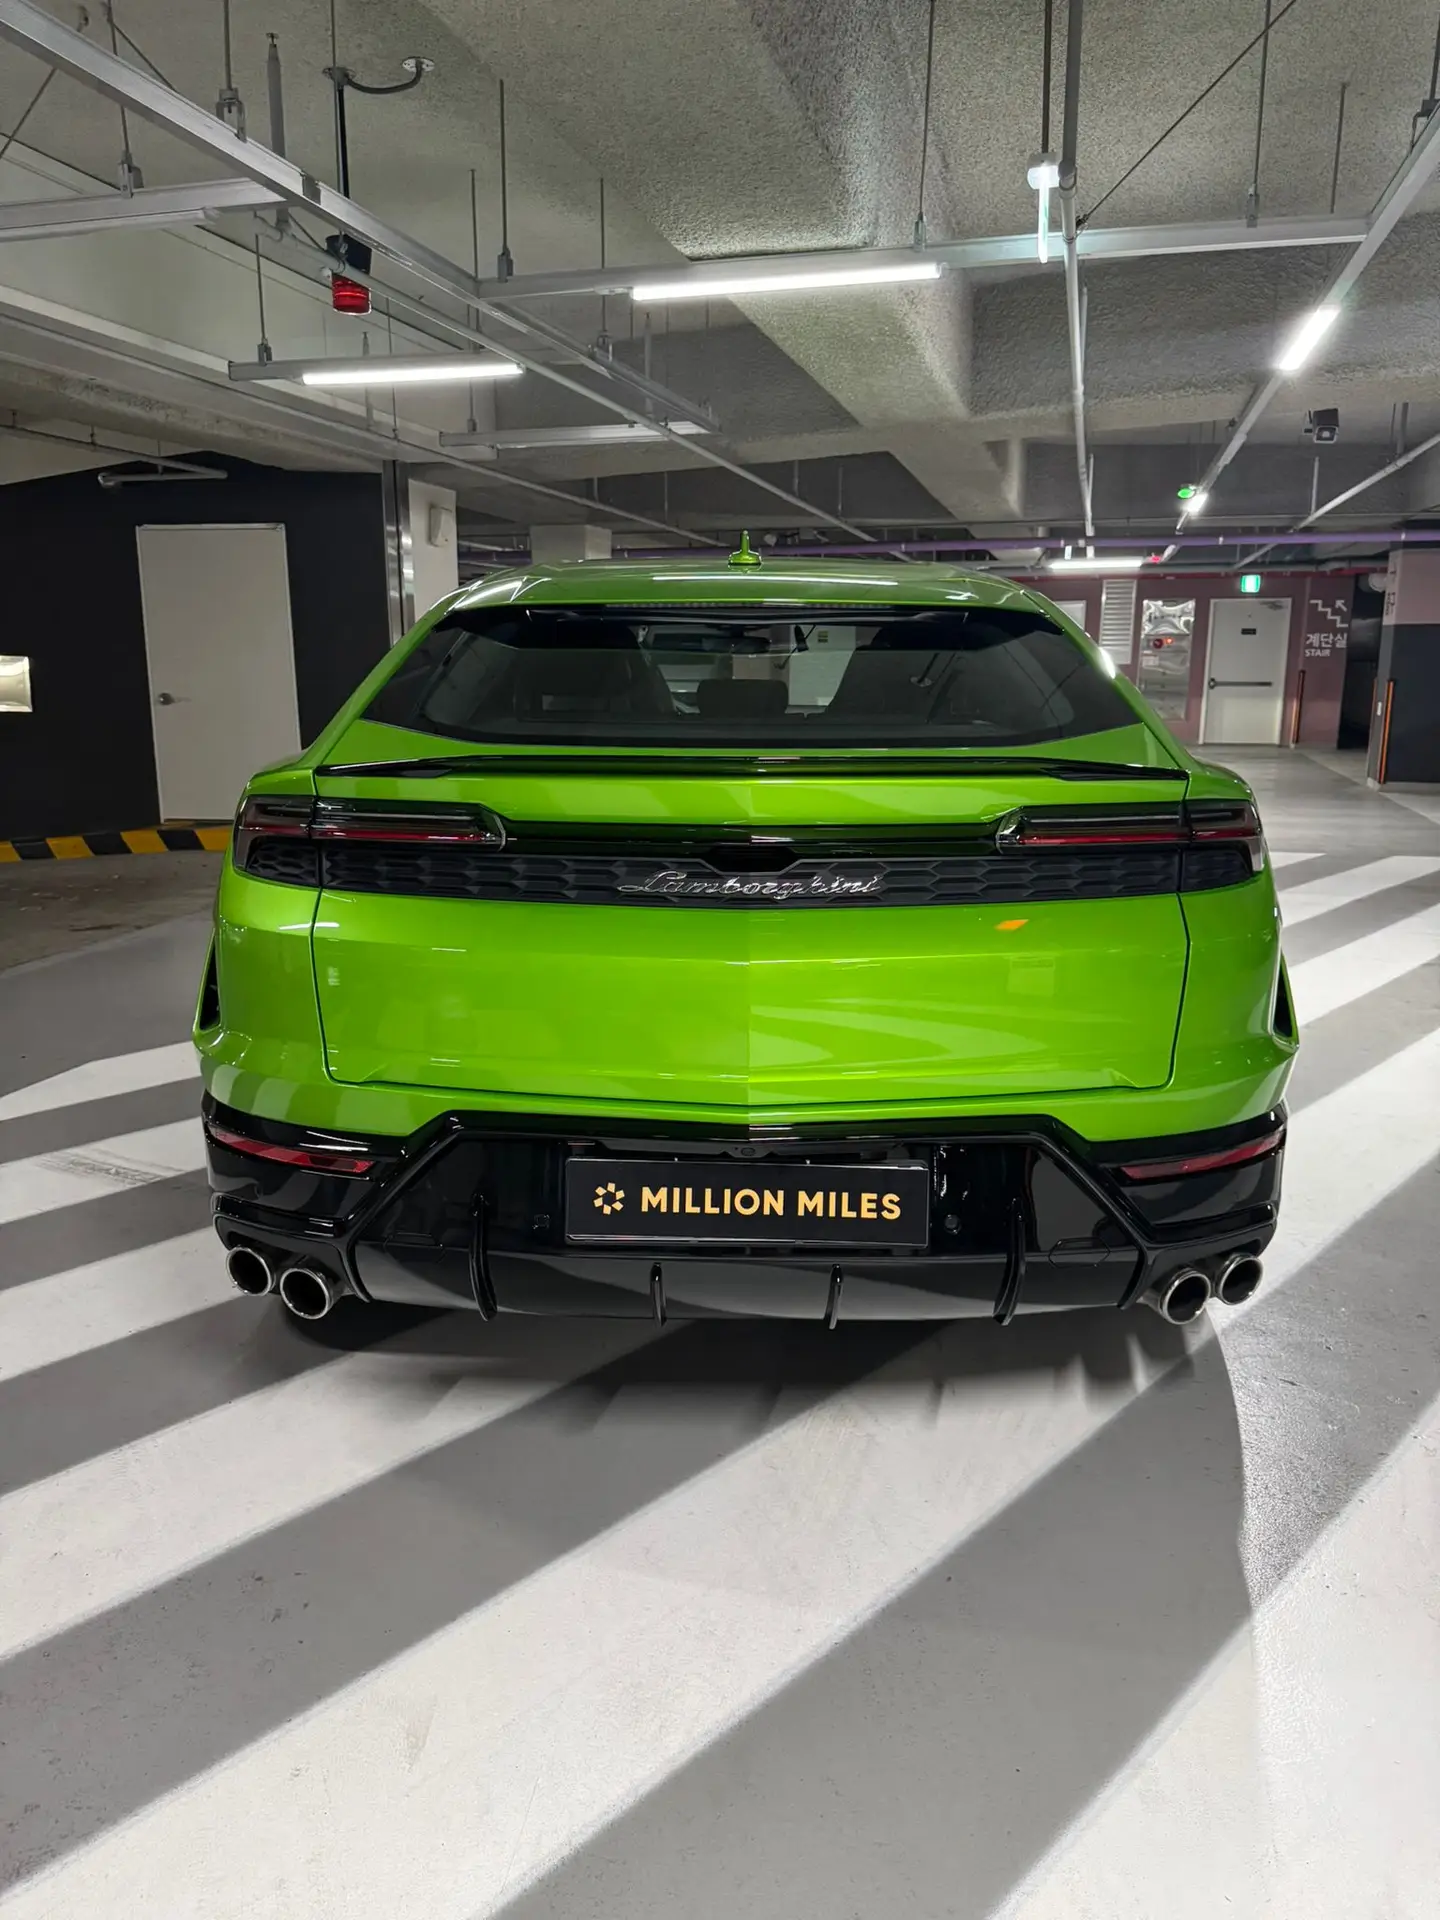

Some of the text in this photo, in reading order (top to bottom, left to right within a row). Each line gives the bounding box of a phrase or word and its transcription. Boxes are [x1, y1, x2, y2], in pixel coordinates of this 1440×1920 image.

[1304, 648, 1331, 657] STAIR
[1306, 632, 1348, 649] 계단실
[616, 869, 884, 900] Lamborghini
[641, 1186, 901, 1220] MILLION MILES
